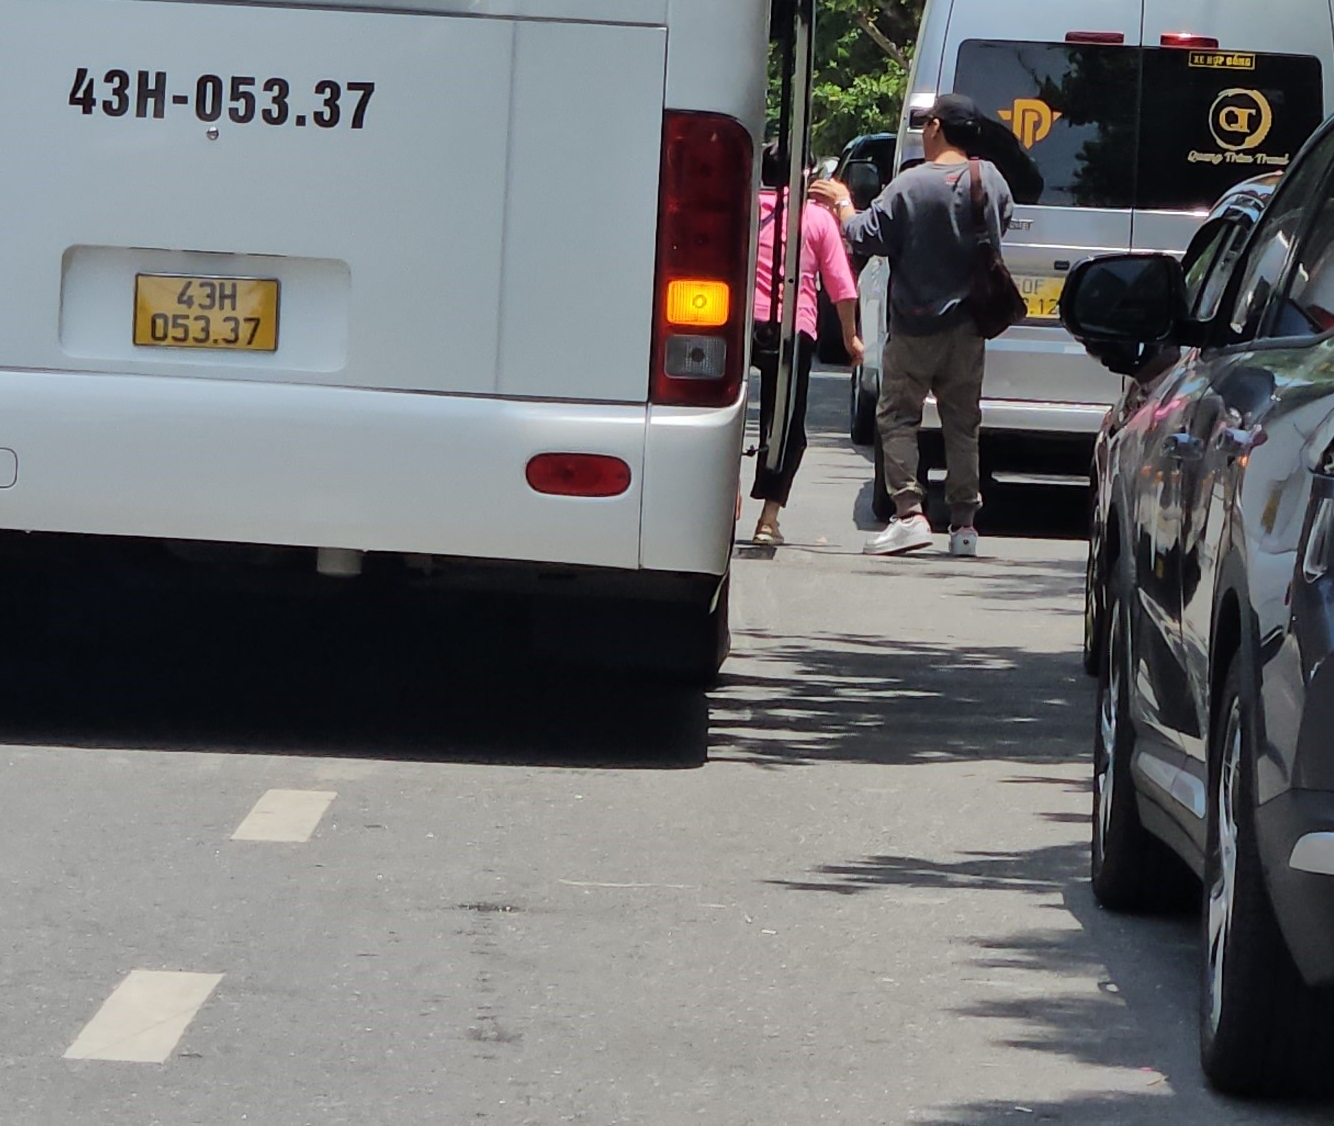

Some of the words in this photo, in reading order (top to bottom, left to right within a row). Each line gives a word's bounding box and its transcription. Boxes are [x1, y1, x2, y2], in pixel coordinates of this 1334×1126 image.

[1193, 55, 1205, 64] XE
[68, 67, 376, 130] 43H-053.37
[177, 281, 237, 311] 43H
[151, 313, 260, 345] 053.37
